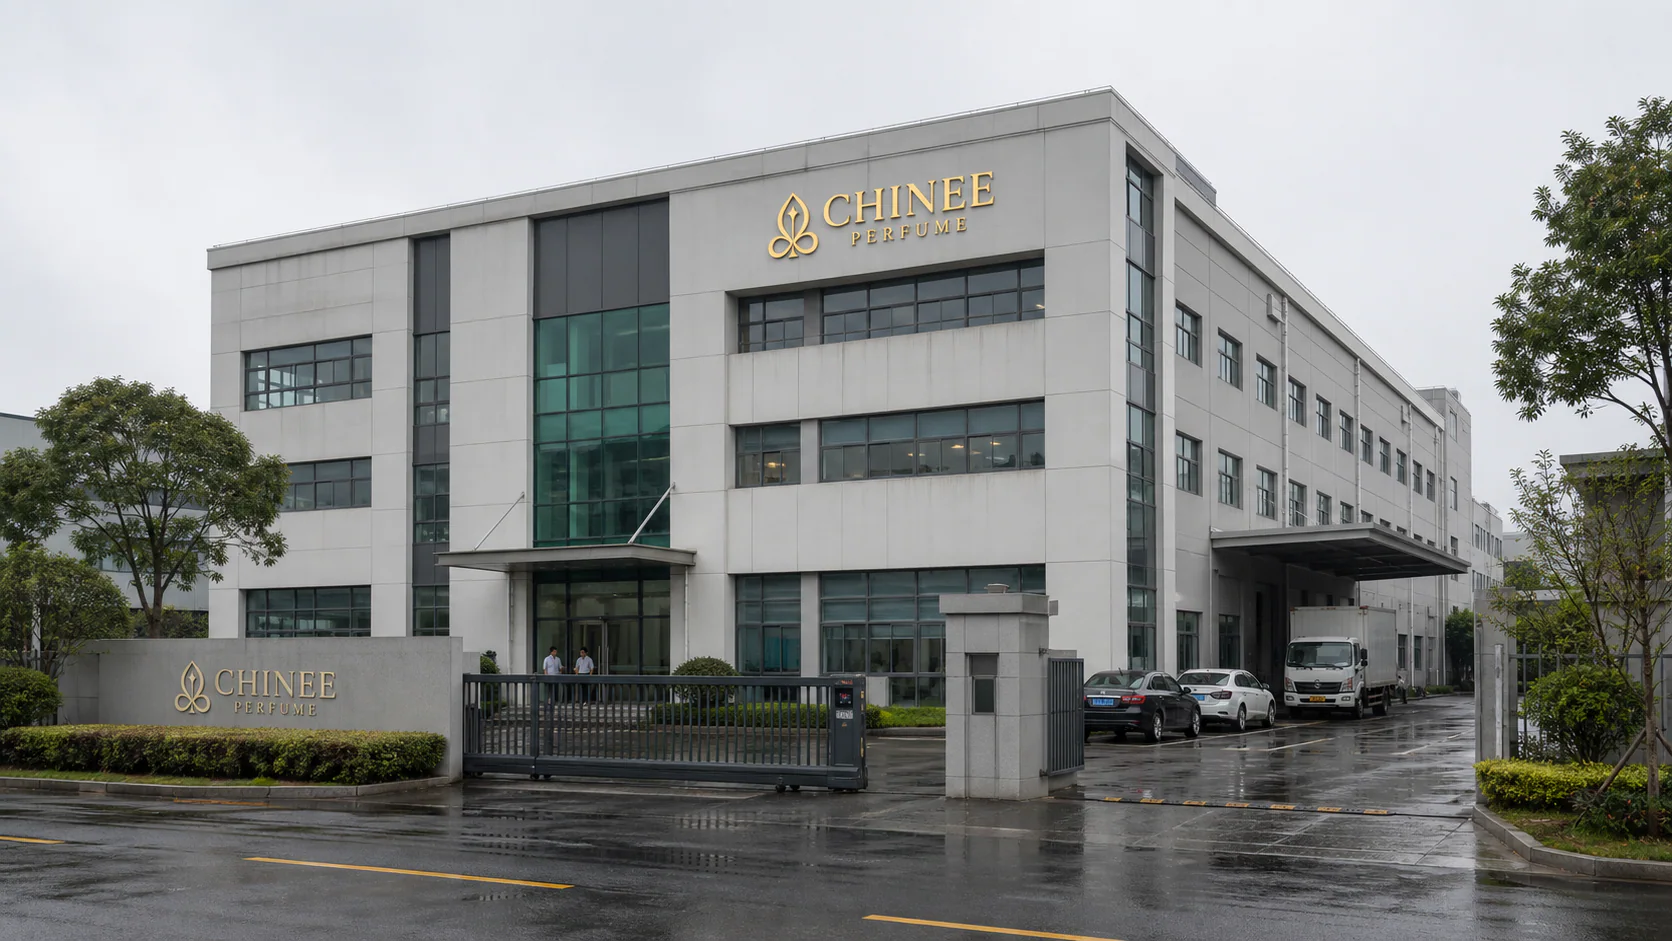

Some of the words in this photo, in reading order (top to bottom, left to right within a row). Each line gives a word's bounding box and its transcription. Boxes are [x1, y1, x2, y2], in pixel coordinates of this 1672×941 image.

[823, 171, 995, 227] CHINEE
[851, 217, 968, 246] PERFUME
[215, 668, 337, 699] CHINEE
[234, 701, 317, 716] PERFUME
